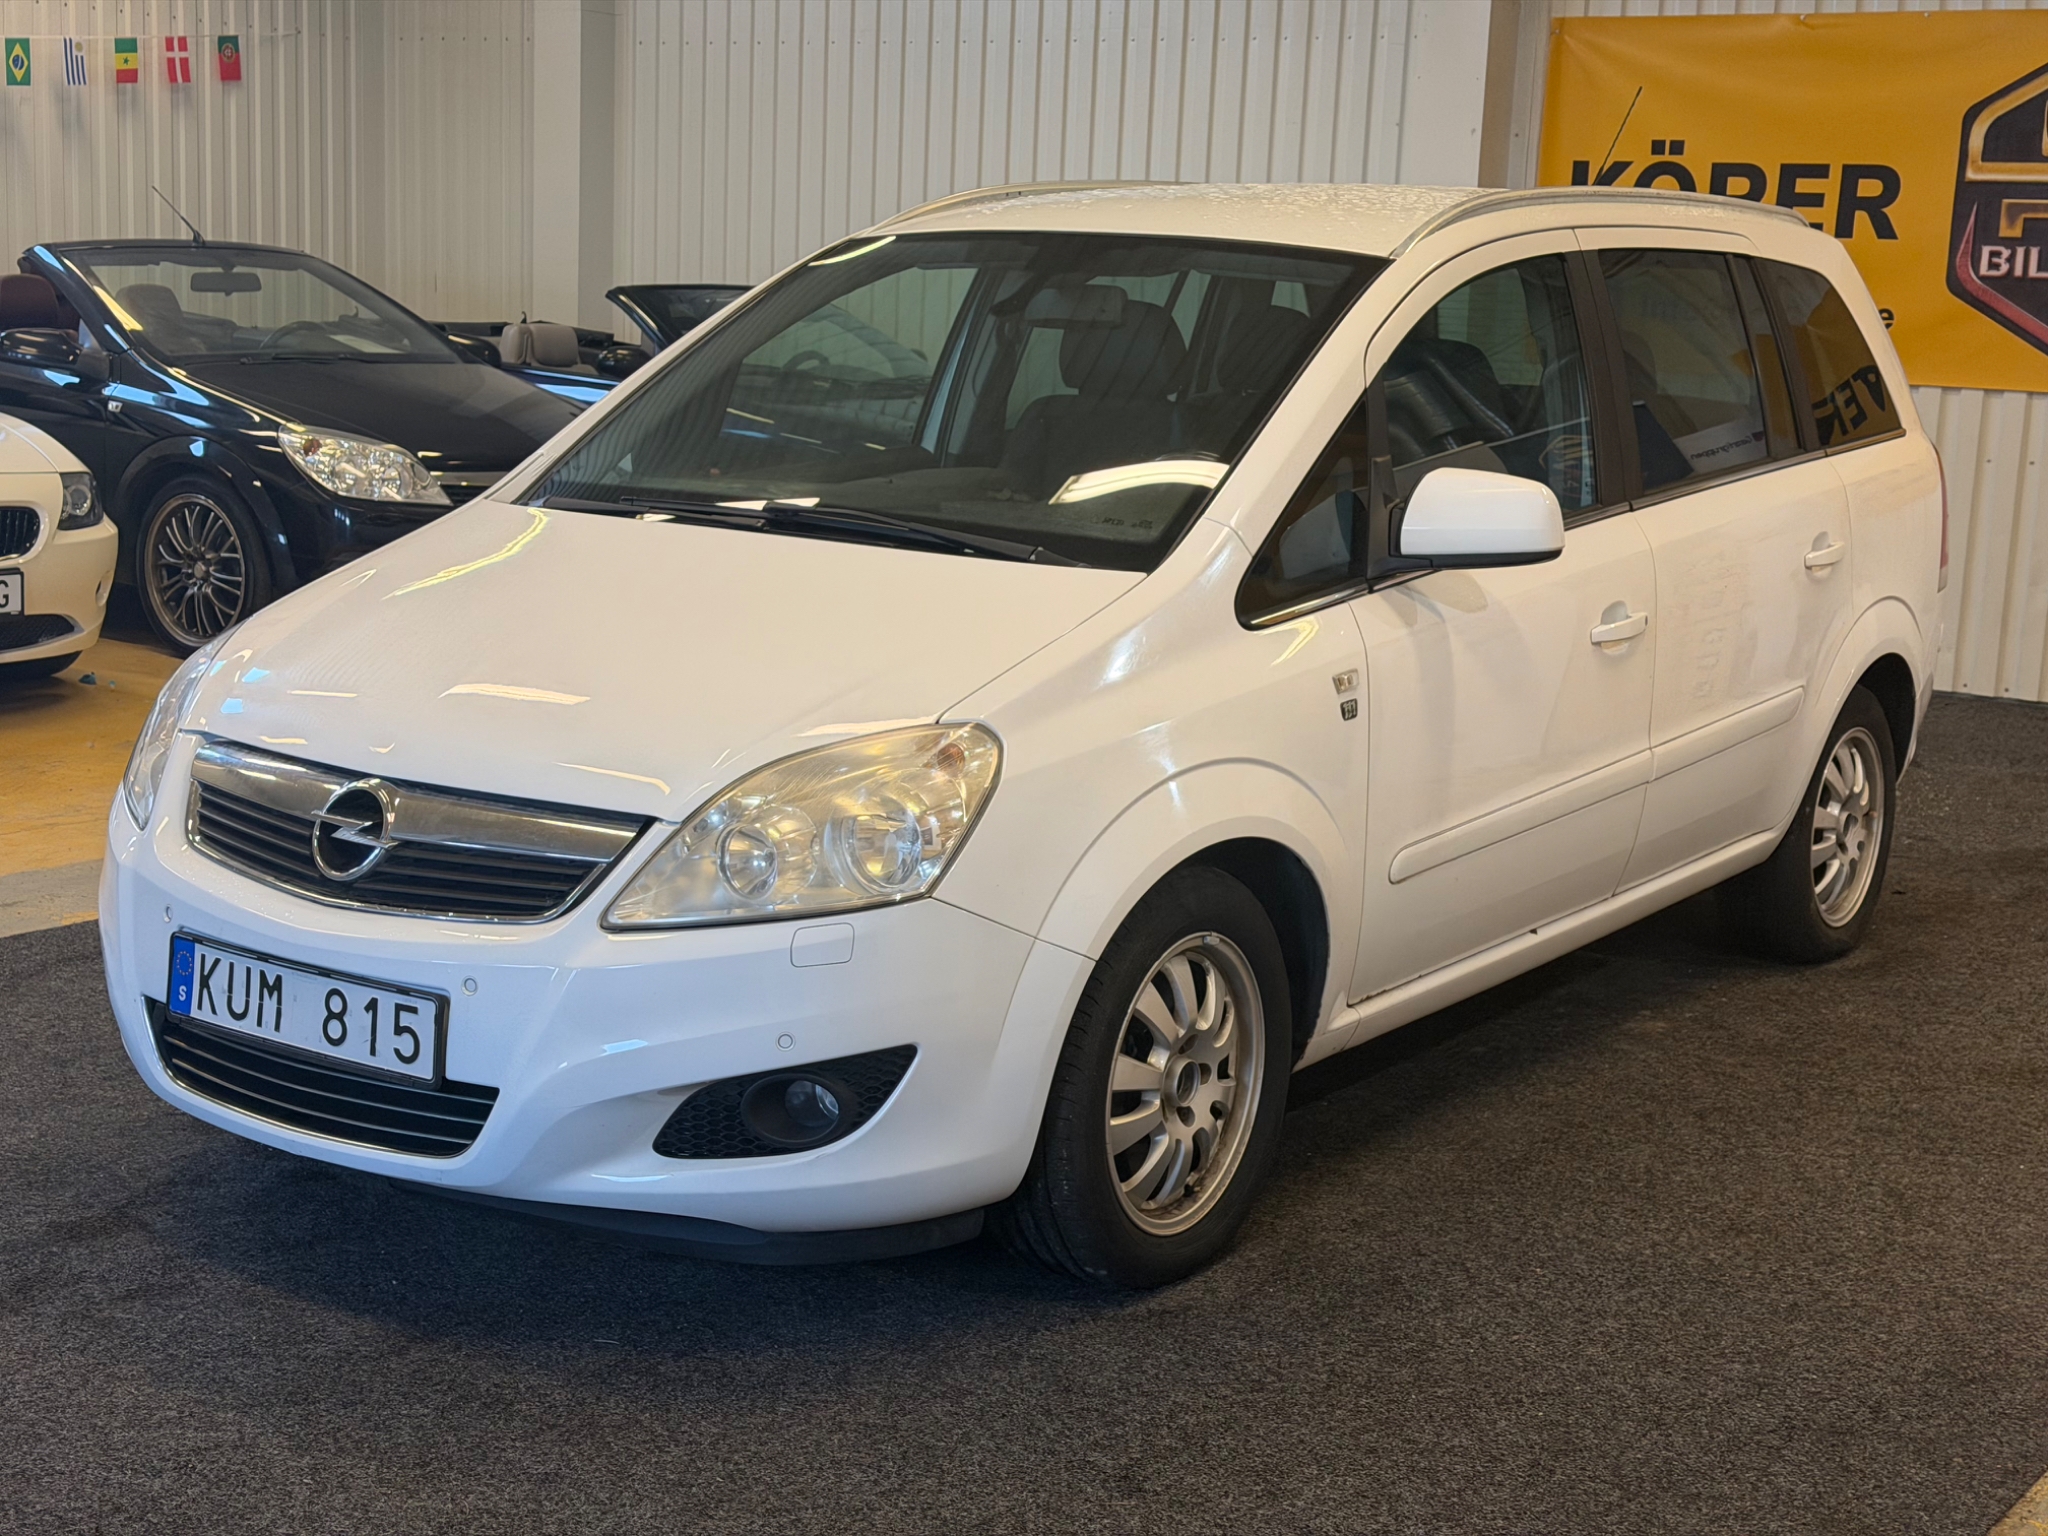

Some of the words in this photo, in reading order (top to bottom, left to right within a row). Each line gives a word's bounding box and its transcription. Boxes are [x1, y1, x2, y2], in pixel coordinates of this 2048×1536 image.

[178, 984, 187, 1001] S
[196, 952, 283, 1033] KUM
[321, 987, 421, 1065] 815
